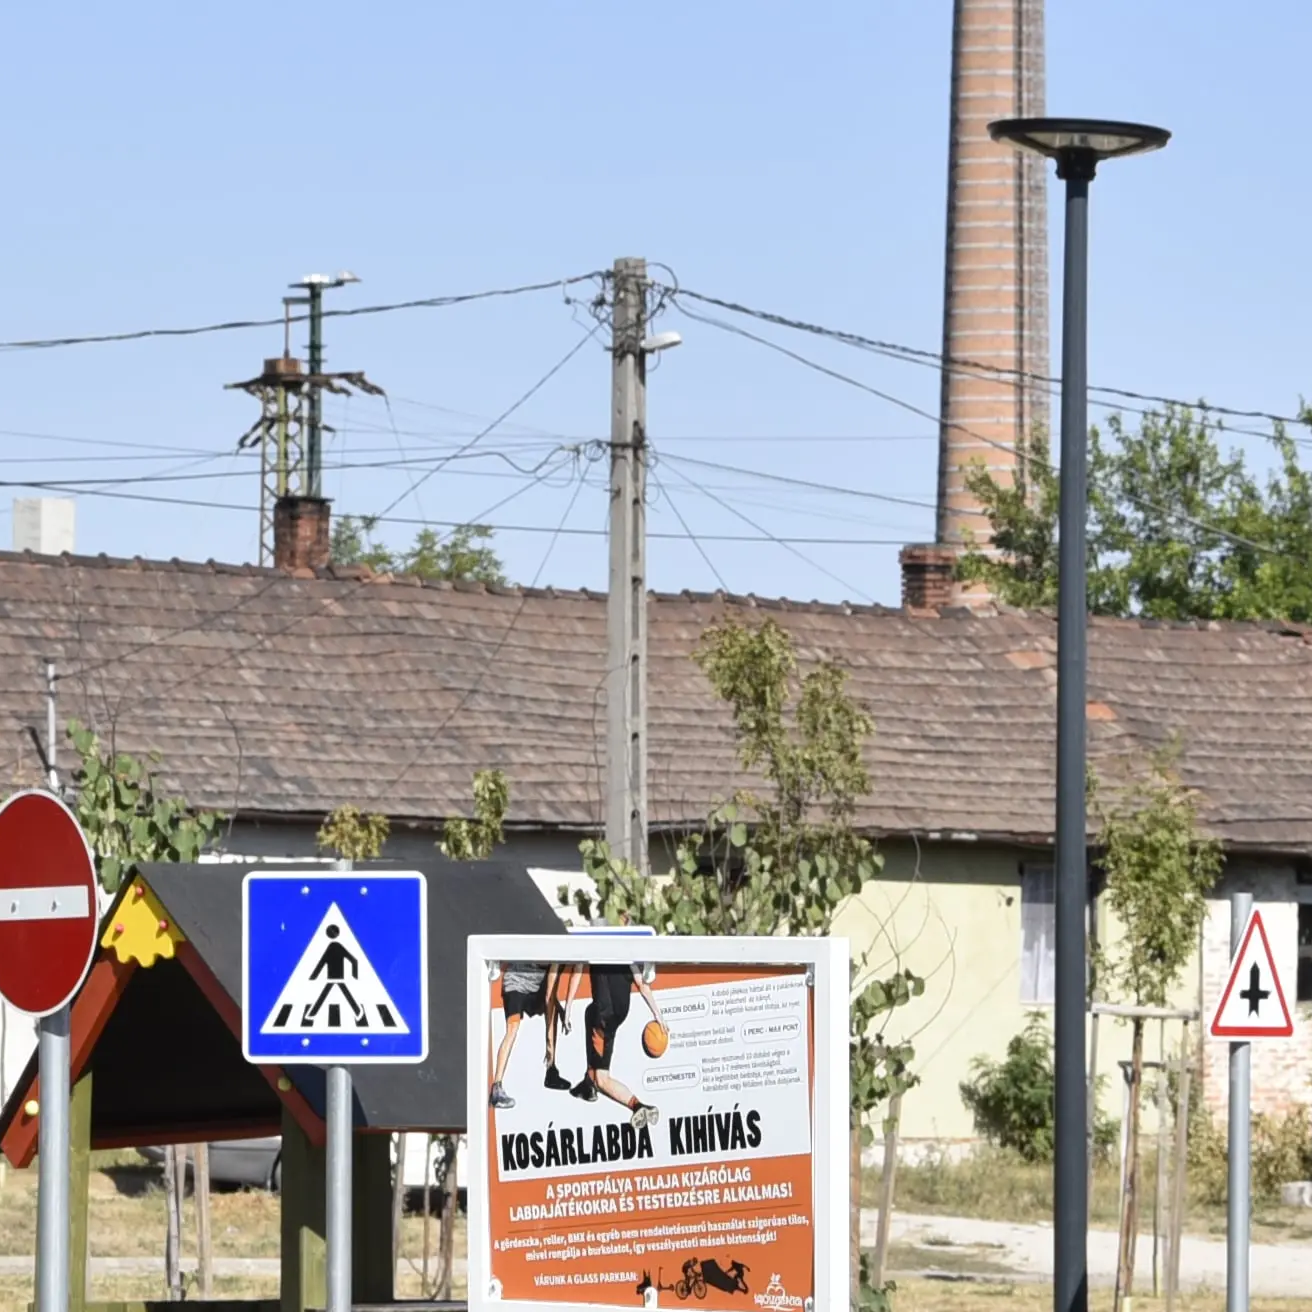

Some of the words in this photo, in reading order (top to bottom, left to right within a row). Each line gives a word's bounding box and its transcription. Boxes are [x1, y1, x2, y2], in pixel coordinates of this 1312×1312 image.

[683, 1001, 706, 1013] DOBÁS
[748, 1027, 764, 1036] PERC
[782, 1023, 799, 1033] PONT
[501, 1122, 654, 1172] KOSÁRLABDA
[668, 1103, 762, 1156] KIHÍVÁS
[546, 1184, 556, 1200] A
[557, 1175, 633, 1199] SPORTPÁLYA
[634, 1172, 679, 1191] TALAJA
[681, 1164, 751, 1188] KIZÁRÓLAG
[509, 1198, 617, 1221] LABDAJÁTÉKOKRA
[619, 1193, 635, 1213] ÉS
[636, 1186, 721, 1211] TESTEDZÉSRE
[722, 1182, 793, 1204] ALKALMAS!
[494, 1239, 500, 1250] A
[500, 1236, 542, 1252] gördeszka,
[543, 1232, 567, 1246] roller,
[568, 1231, 585, 1243] BMX
[586, 1230, 596, 1241] és
[596, 1228, 620, 1243] egyéb
[621, 1229, 639, 1240] nem
[640, 1220, 706, 1238] rendeltetésszerű
[707, 1218, 746, 1232] használat
[747, 1215, 787, 1231] szigorúan
[788, 1214, 809, 1227] tilos,
[525, 1249, 547, 1261] mivel
[548, 1246, 581, 1261] rongálja
[588, 1241, 633, 1257] burkolatot,
[633, 1240, 645, 1255] így
[646, 1236, 698, 1252] veszélyezteti
[700, 1234, 726, 1247] mások
[727, 1230, 777, 1246] biztonságát!
[533, 1272, 566, 1286] VÁRUNK
[567, 1274, 573, 1284] A
[573, 1273, 599, 1284] GLASS
